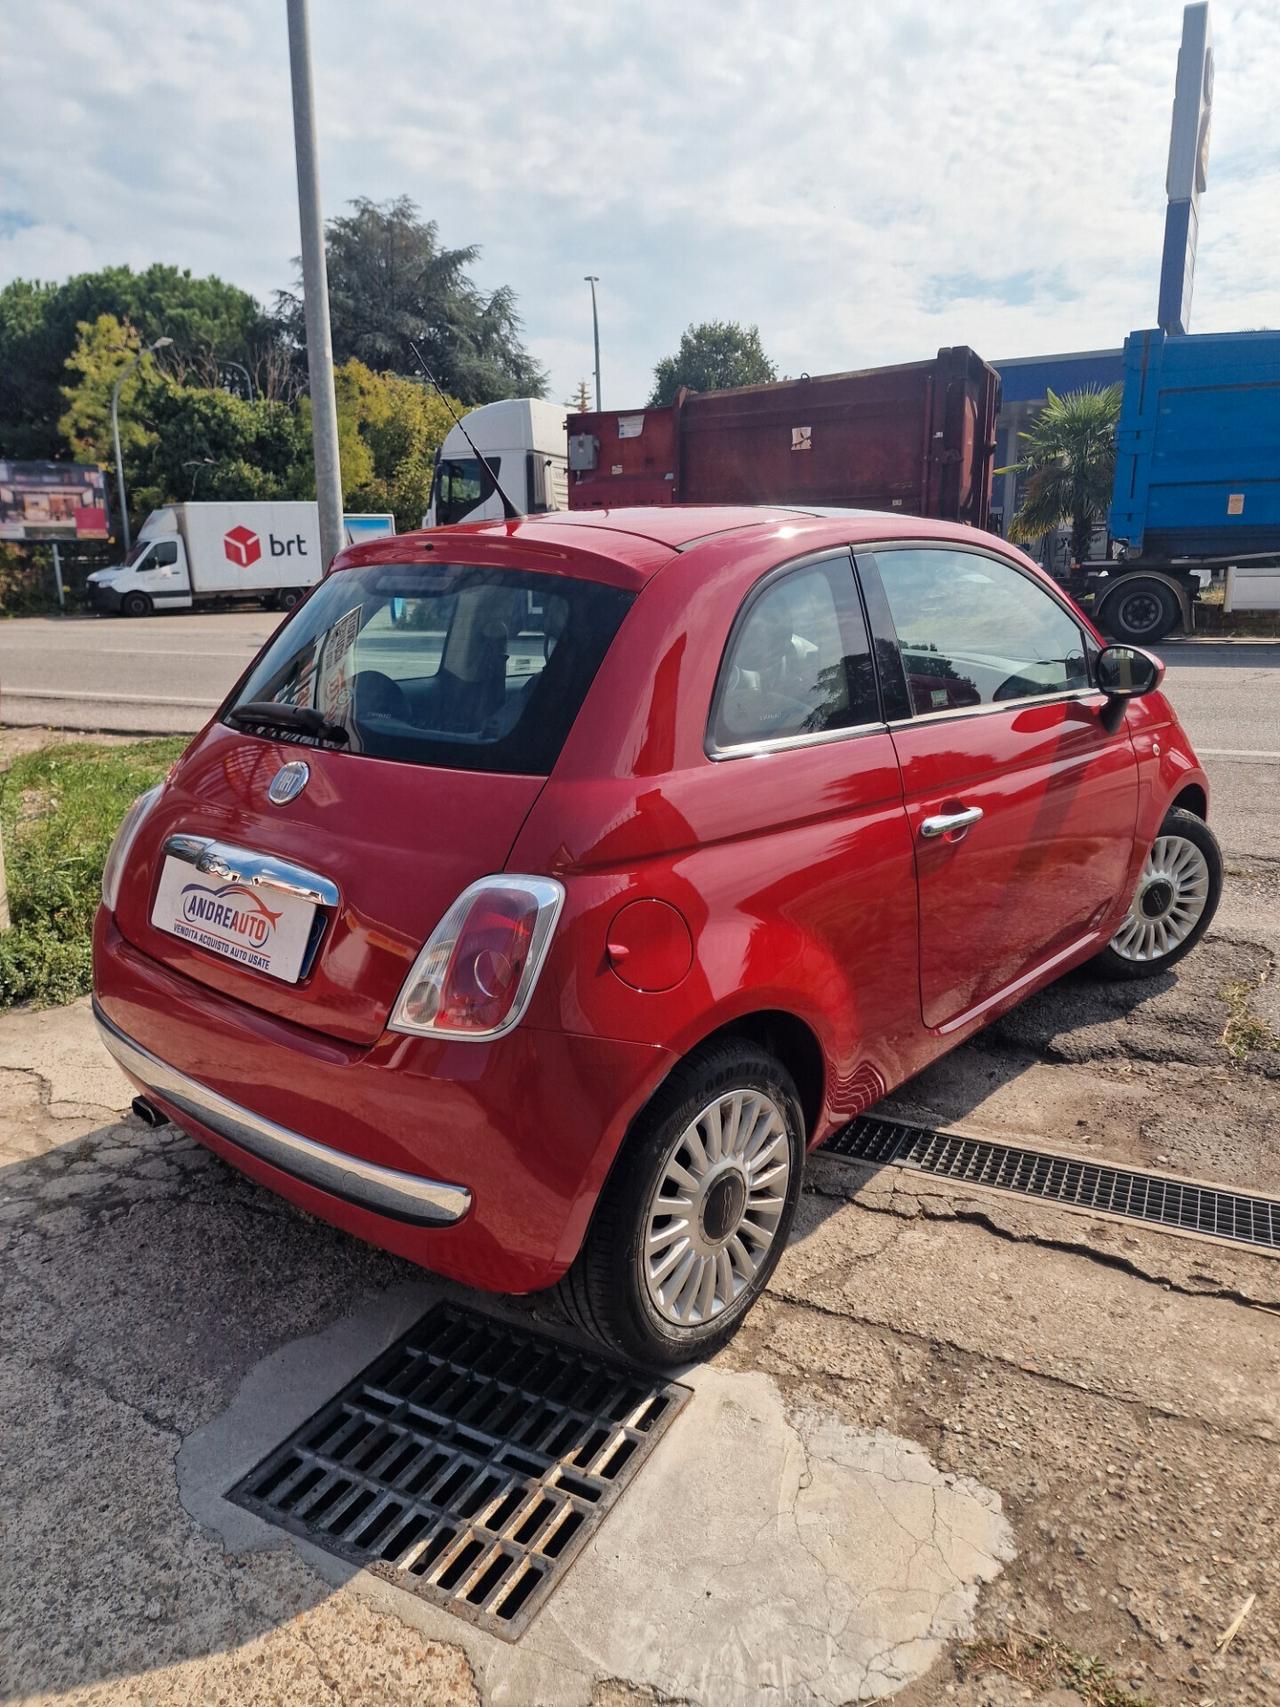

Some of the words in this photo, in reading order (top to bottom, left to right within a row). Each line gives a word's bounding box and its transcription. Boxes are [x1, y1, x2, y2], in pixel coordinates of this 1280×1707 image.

[269, 534, 308, 557] brt
[188, 895, 267, 941] ANDREAUTO
[173, 923, 198, 942] VENDITA
[199, 933, 229, 954] ACQUISTO
[230, 947, 248, 961] AUTO
[248, 954, 271, 970] USATE
